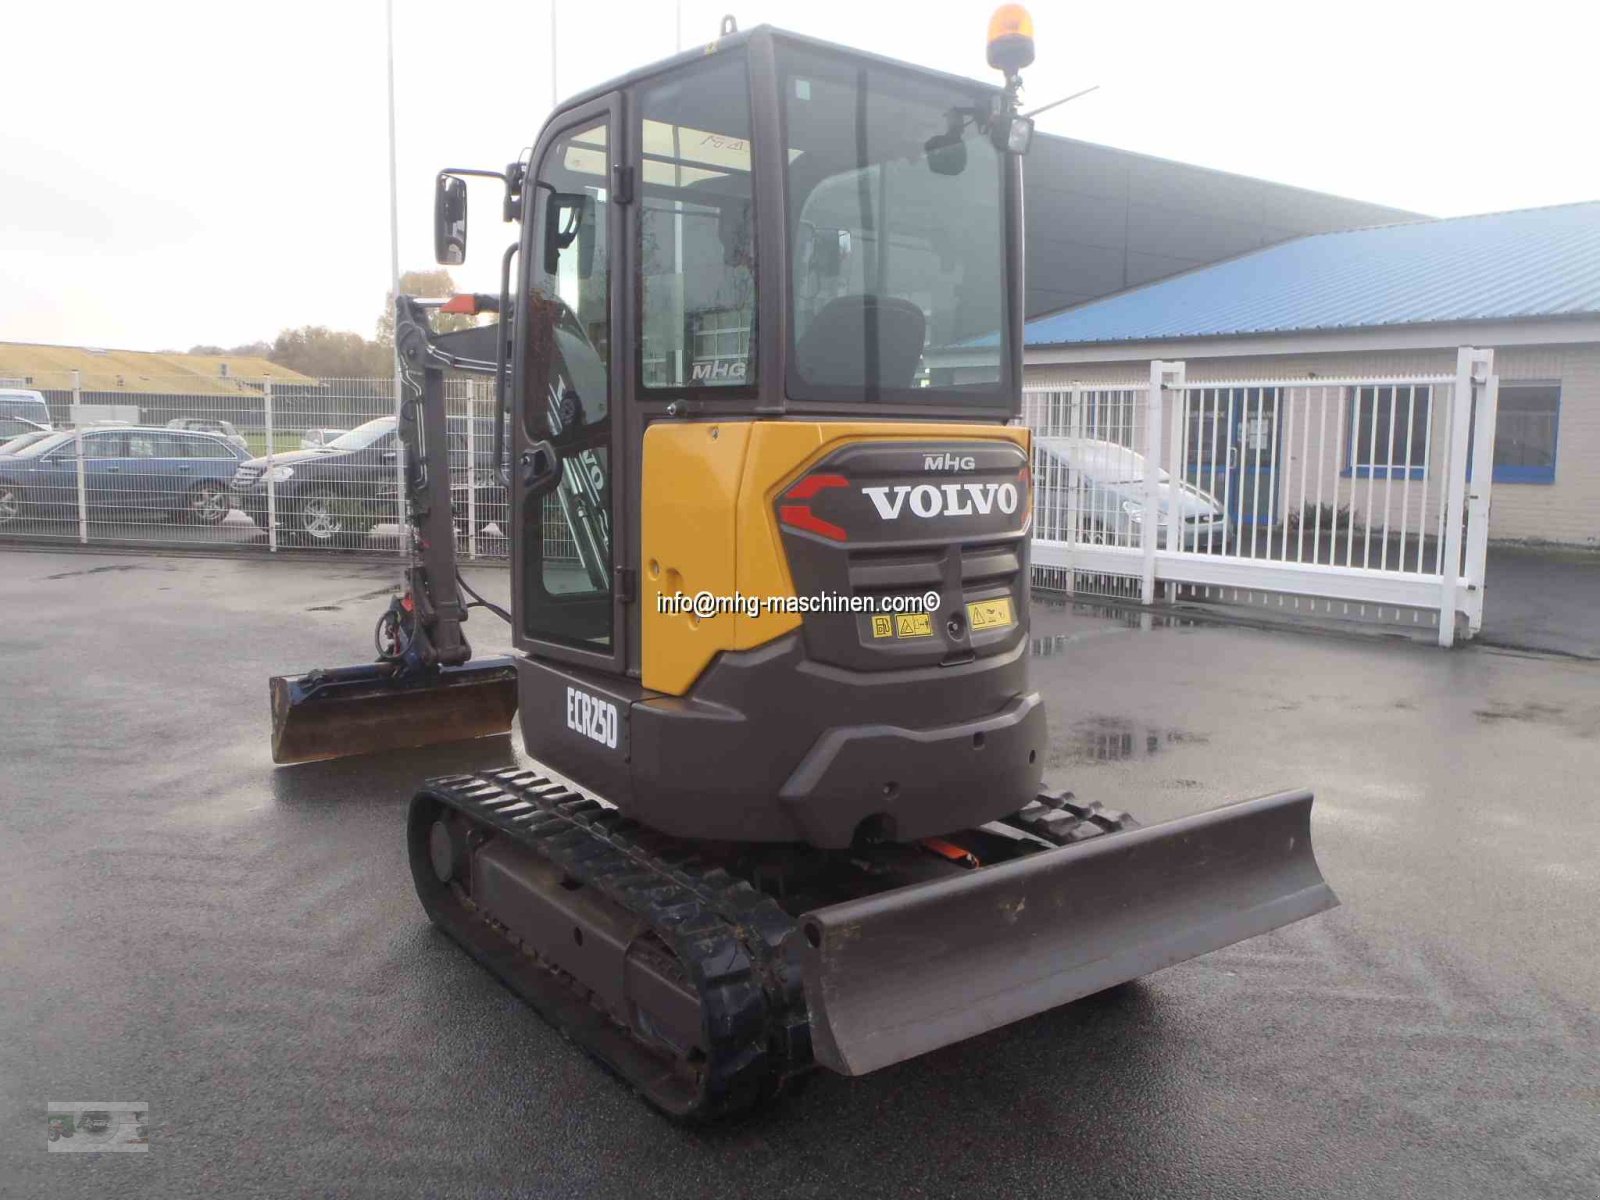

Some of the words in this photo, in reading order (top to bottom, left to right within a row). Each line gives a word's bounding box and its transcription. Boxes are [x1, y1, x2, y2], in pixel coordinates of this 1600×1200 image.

[693, 360, 746, 380] MHG
[923, 453, 976, 472] MHG
[862, 483, 1018, 520] VOLVO
[567, 686, 618, 749] ECR25D
